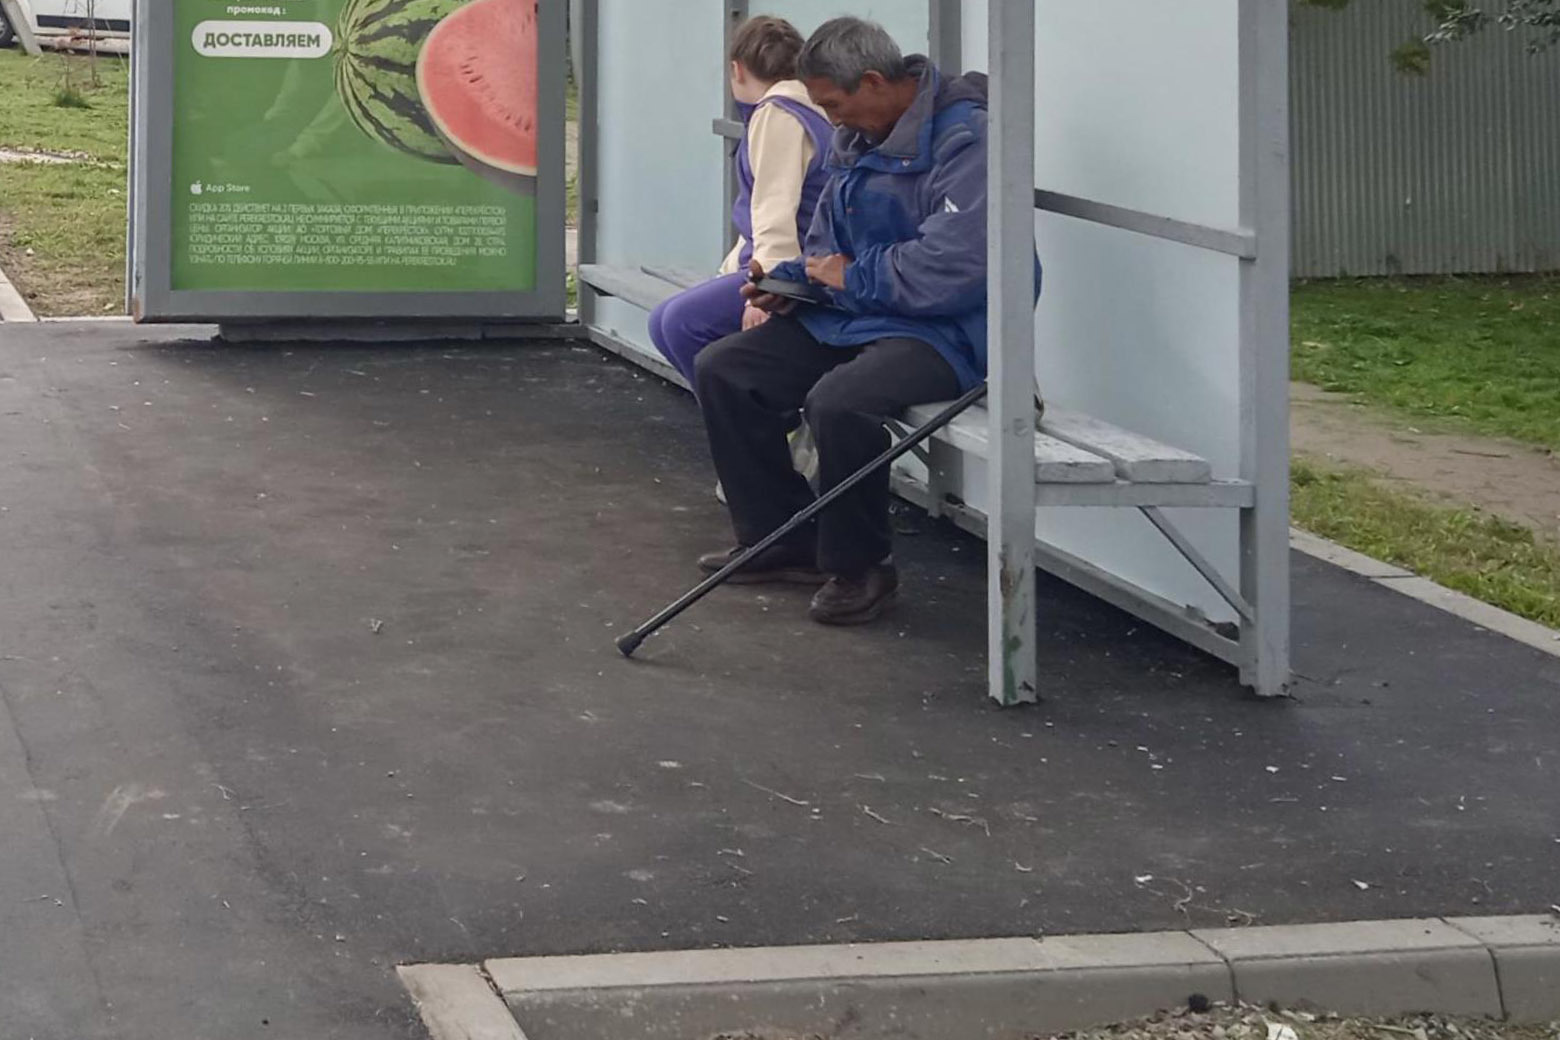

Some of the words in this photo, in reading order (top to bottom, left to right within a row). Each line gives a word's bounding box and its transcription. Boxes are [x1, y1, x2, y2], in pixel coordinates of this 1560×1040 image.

[203, 32, 321, 49] ДОСТАВЛЯЕМ
[206, 183, 225, 193] App
[226, 183, 251, 193] Store
